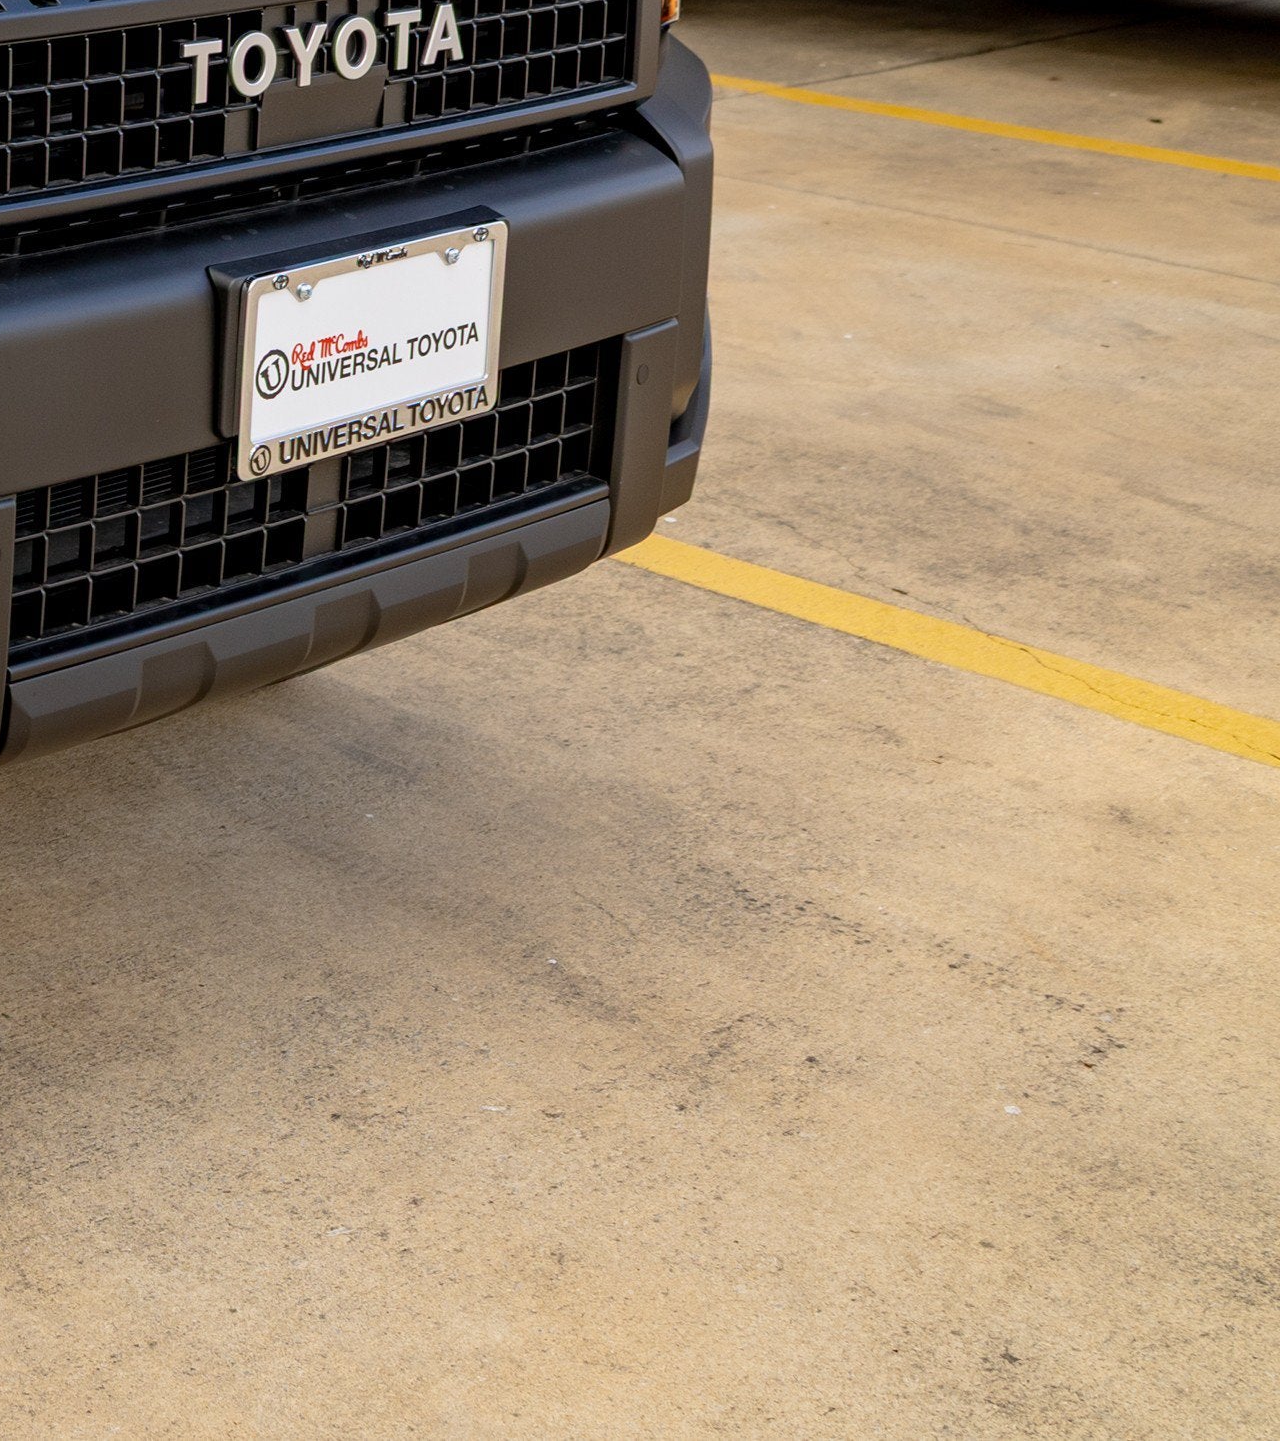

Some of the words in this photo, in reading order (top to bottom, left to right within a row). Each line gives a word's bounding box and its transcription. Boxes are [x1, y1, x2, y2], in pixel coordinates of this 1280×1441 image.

[179, 2, 465, 106] TOYOTA
[291, 341, 317, 372] Red
[318, 329, 369, 358] McCombs
[291, 342, 403, 392] UNIVERSAL
[406, 321, 479, 360] TOYOTA
[278, 406, 405, 464] UNIVERSAL
[405, 384, 489, 427] TOYOTA
